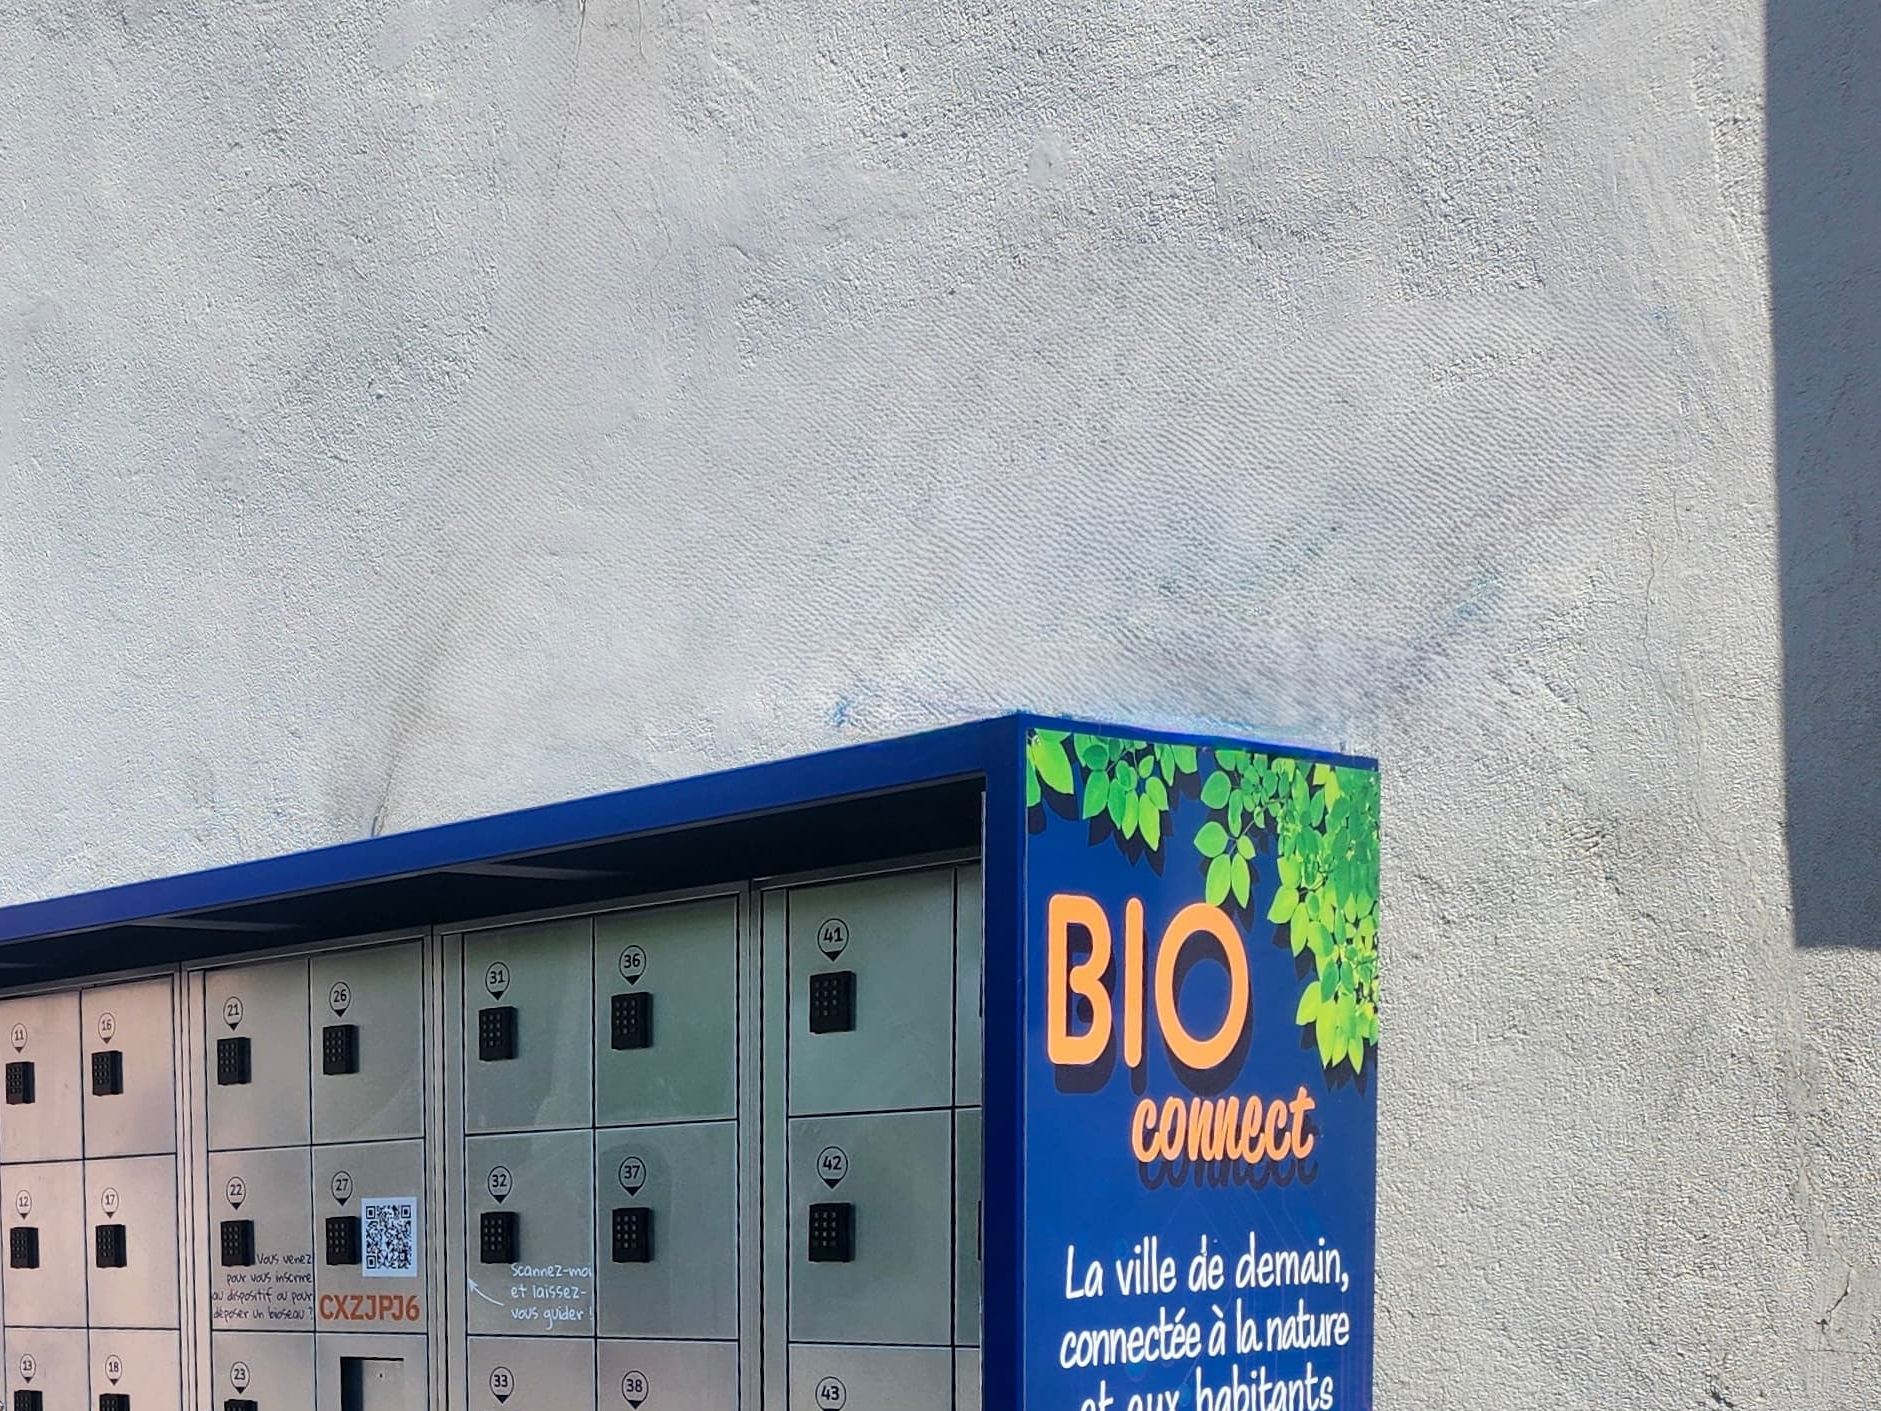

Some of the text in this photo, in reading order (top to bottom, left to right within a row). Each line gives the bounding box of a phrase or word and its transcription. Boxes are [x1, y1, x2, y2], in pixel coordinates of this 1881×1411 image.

[822, 925, 844, 943] 41
[624, 953, 641, 969] 36
[488, 970, 506, 985] 31
[1048, 894, 1249, 1069] BIO
[332, 988, 347, 1003] 26
[227, 1003, 240, 1017] 21
[101, 1018, 112, 1031] 16
[14, 1030, 25, 1042] 11
[1132, 1087, 1315, 1163] connect
[822, 1155, 842, 1171] 42
[624, 1165, 641, 1180] 37
[335, 1178, 349, 1192] 27
[492, 1173, 507, 1188] 32
[230, 1184, 243, 1197] 22
[19, 1195, 30, 1208] 12
[105, 1194, 116, 1206] 17
[256, 1253, 312, 1265] Vous venez
[1066, 1231, 1350, 1299] La ville de demain,
[510, 1263, 593, 1278] Scannez-moi
[226, 1271, 313, 1287] pour vous inscrire
[510, 1283, 588, 1299] et laissez-
[252, 1310, 265, 1319] un
[319, 1294, 421, 1322] CXZJPJ6
[510, 1306, 539, 1320] vous
[543, 1305, 584, 1331] guider
[1060, 1298, 1350, 1369] connectée à la nature
[21, 1359, 34, 1371] 13
[109, 1361, 120, 1373] 18
[232, 1367, 248, 1381] 23
[494, 1374, 508, 1388] 33
[626, 1378, 643, 1393] 38
[821, 1385, 840, 1401] 43
